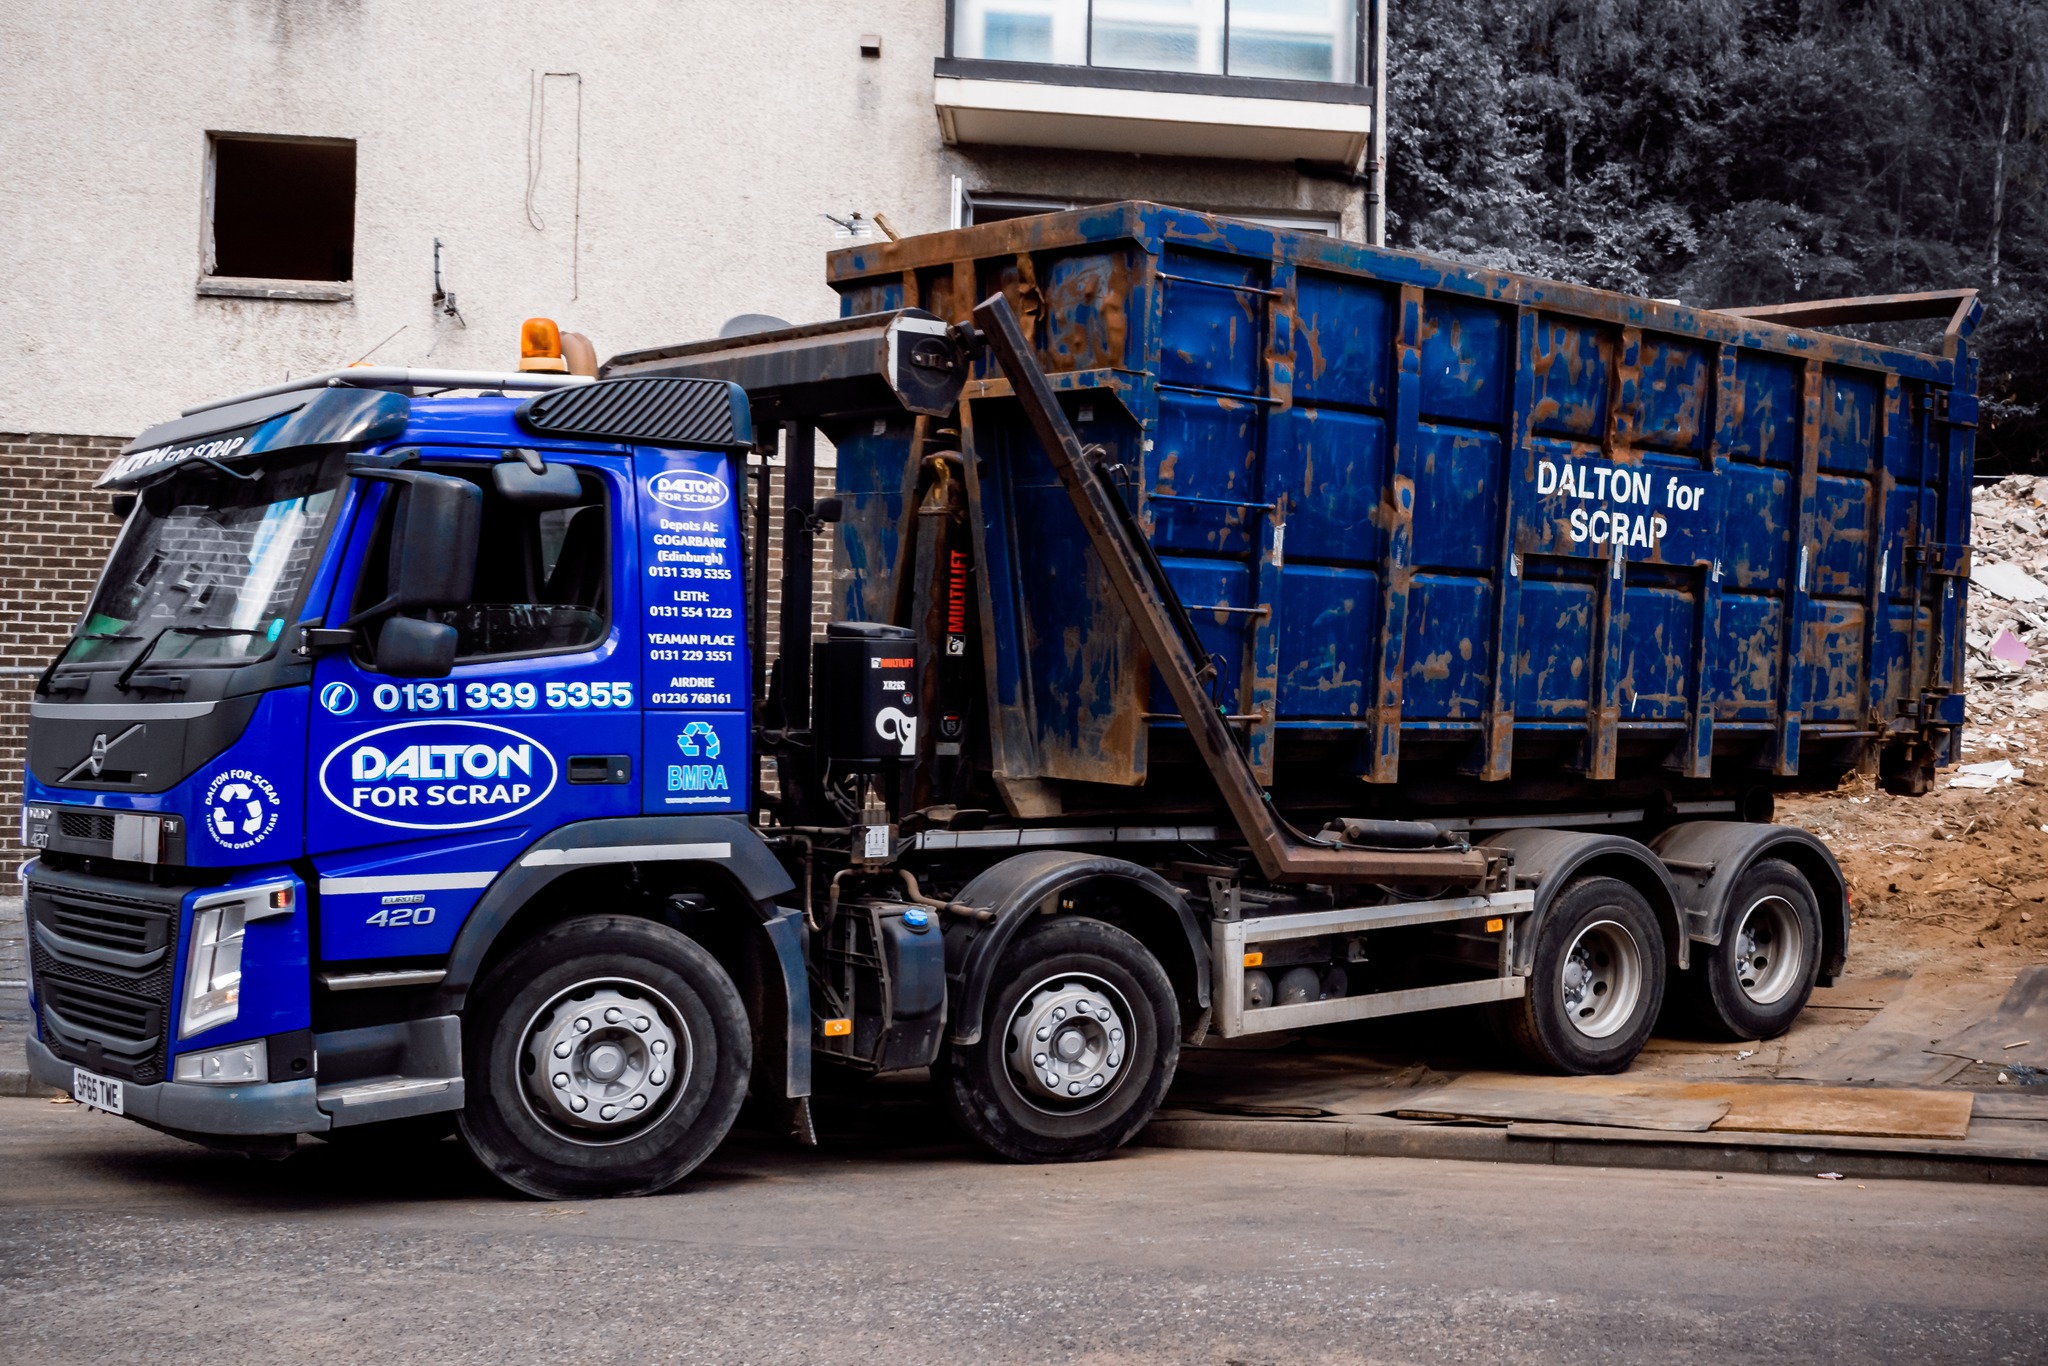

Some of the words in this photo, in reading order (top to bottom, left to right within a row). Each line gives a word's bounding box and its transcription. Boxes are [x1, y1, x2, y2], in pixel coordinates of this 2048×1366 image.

[193, 436, 245, 459] SCRAP
[657, 478, 720, 494] DALTON
[1537, 460, 1651, 505] DALTON
[1666, 476, 1705, 511] for
[658, 492, 682, 502] FOR
[683, 493, 721, 504] SCRAP
[660, 518, 700, 532] Depots
[702, 521, 719, 532] At:
[1569, 508, 1668, 549] SCRAP
[653, 534, 727, 548] GOGARBANK
[657, 550, 724, 566] (Edinburgh)
[648, 566, 678, 578] 0131
[680, 567, 702, 579] 339
[704, 568, 732, 580] 5355
[673, 590, 710, 602] LEITH:
[947, 549, 968, 633] MULTILIFT
[649, 605, 679, 617] 0131
[681, 606, 703, 618] 554
[705, 607, 733, 619] 1223
[648, 633, 698, 645] YEAMAN
[700, 634, 735, 646] PLACE
[650, 649, 679, 661] 0131
[681, 650, 703, 661] 229
[705, 650, 733, 662] 3551
[880, 658, 914, 668] MULTILIFT
[670, 677, 715, 688] AIRDRIE
[372, 682, 458, 711] 0131
[465, 681, 538, 711] 339
[545, 681, 634, 710] 5355
[652, 692, 688, 704] 01236
[690, 693, 731, 704] 768161
[351, 743, 533, 782] DALTON
[667, 765, 729, 791] BMRA
[205, 771, 229, 806] DALTON
[230, 769, 253, 781] FOR
[251, 774, 281, 805] SCRAP
[352, 786, 419, 808] FOR
[426, 783, 532, 806] SCRAP
[205, 814, 221, 842] TRADING
[219, 839, 233, 849] FOR
[234, 840, 256, 850] OVER
[254, 834, 265, 843] 60
[262, 813, 279, 835] YEARS
[365, 906, 436, 928] 420
[77, 1072, 98, 1102] SF65
[99, 1080, 118, 1108] TWE
